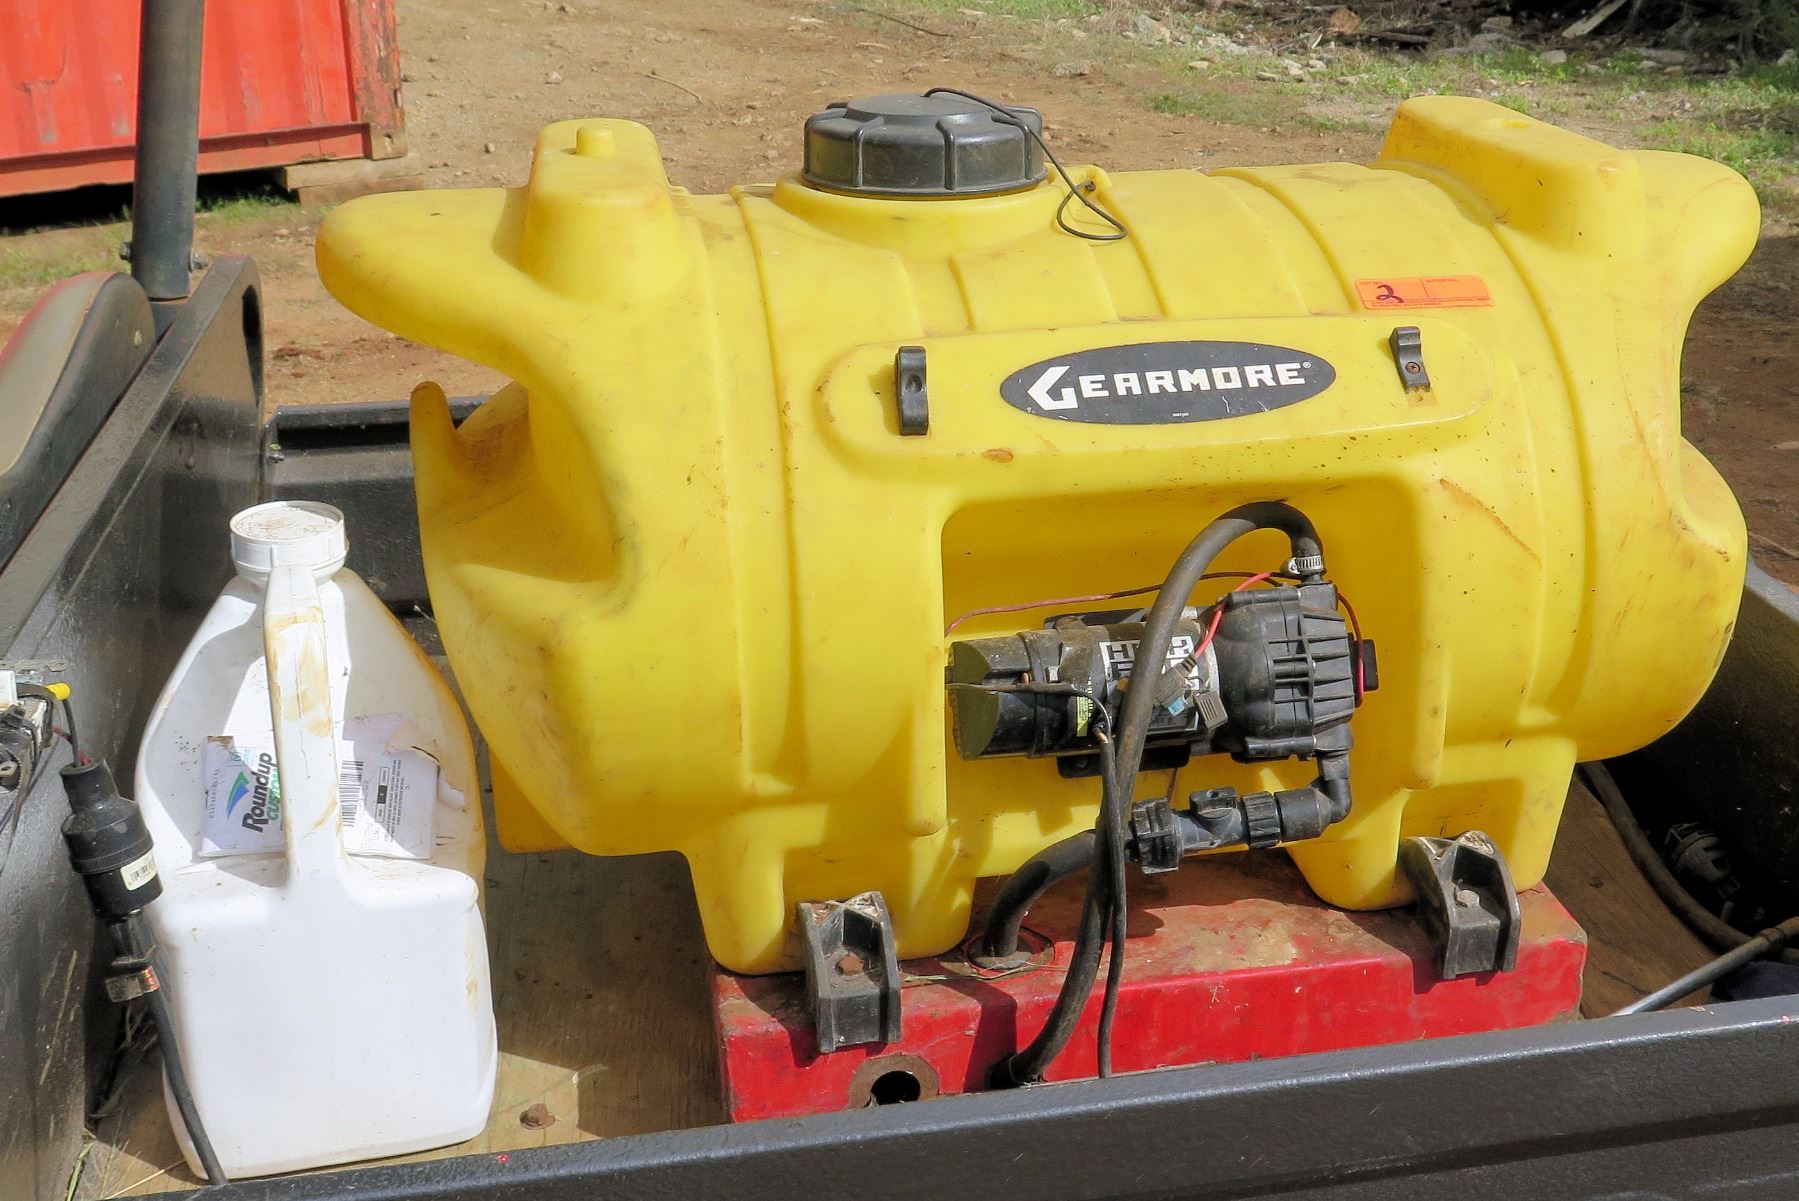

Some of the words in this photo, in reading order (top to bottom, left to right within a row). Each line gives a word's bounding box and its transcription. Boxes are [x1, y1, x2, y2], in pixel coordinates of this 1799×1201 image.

[1376, 284, 1405, 303] 2
[1027, 362, 1306, 411] GEARMORE
[242, 752, 280, 833] Roundup
